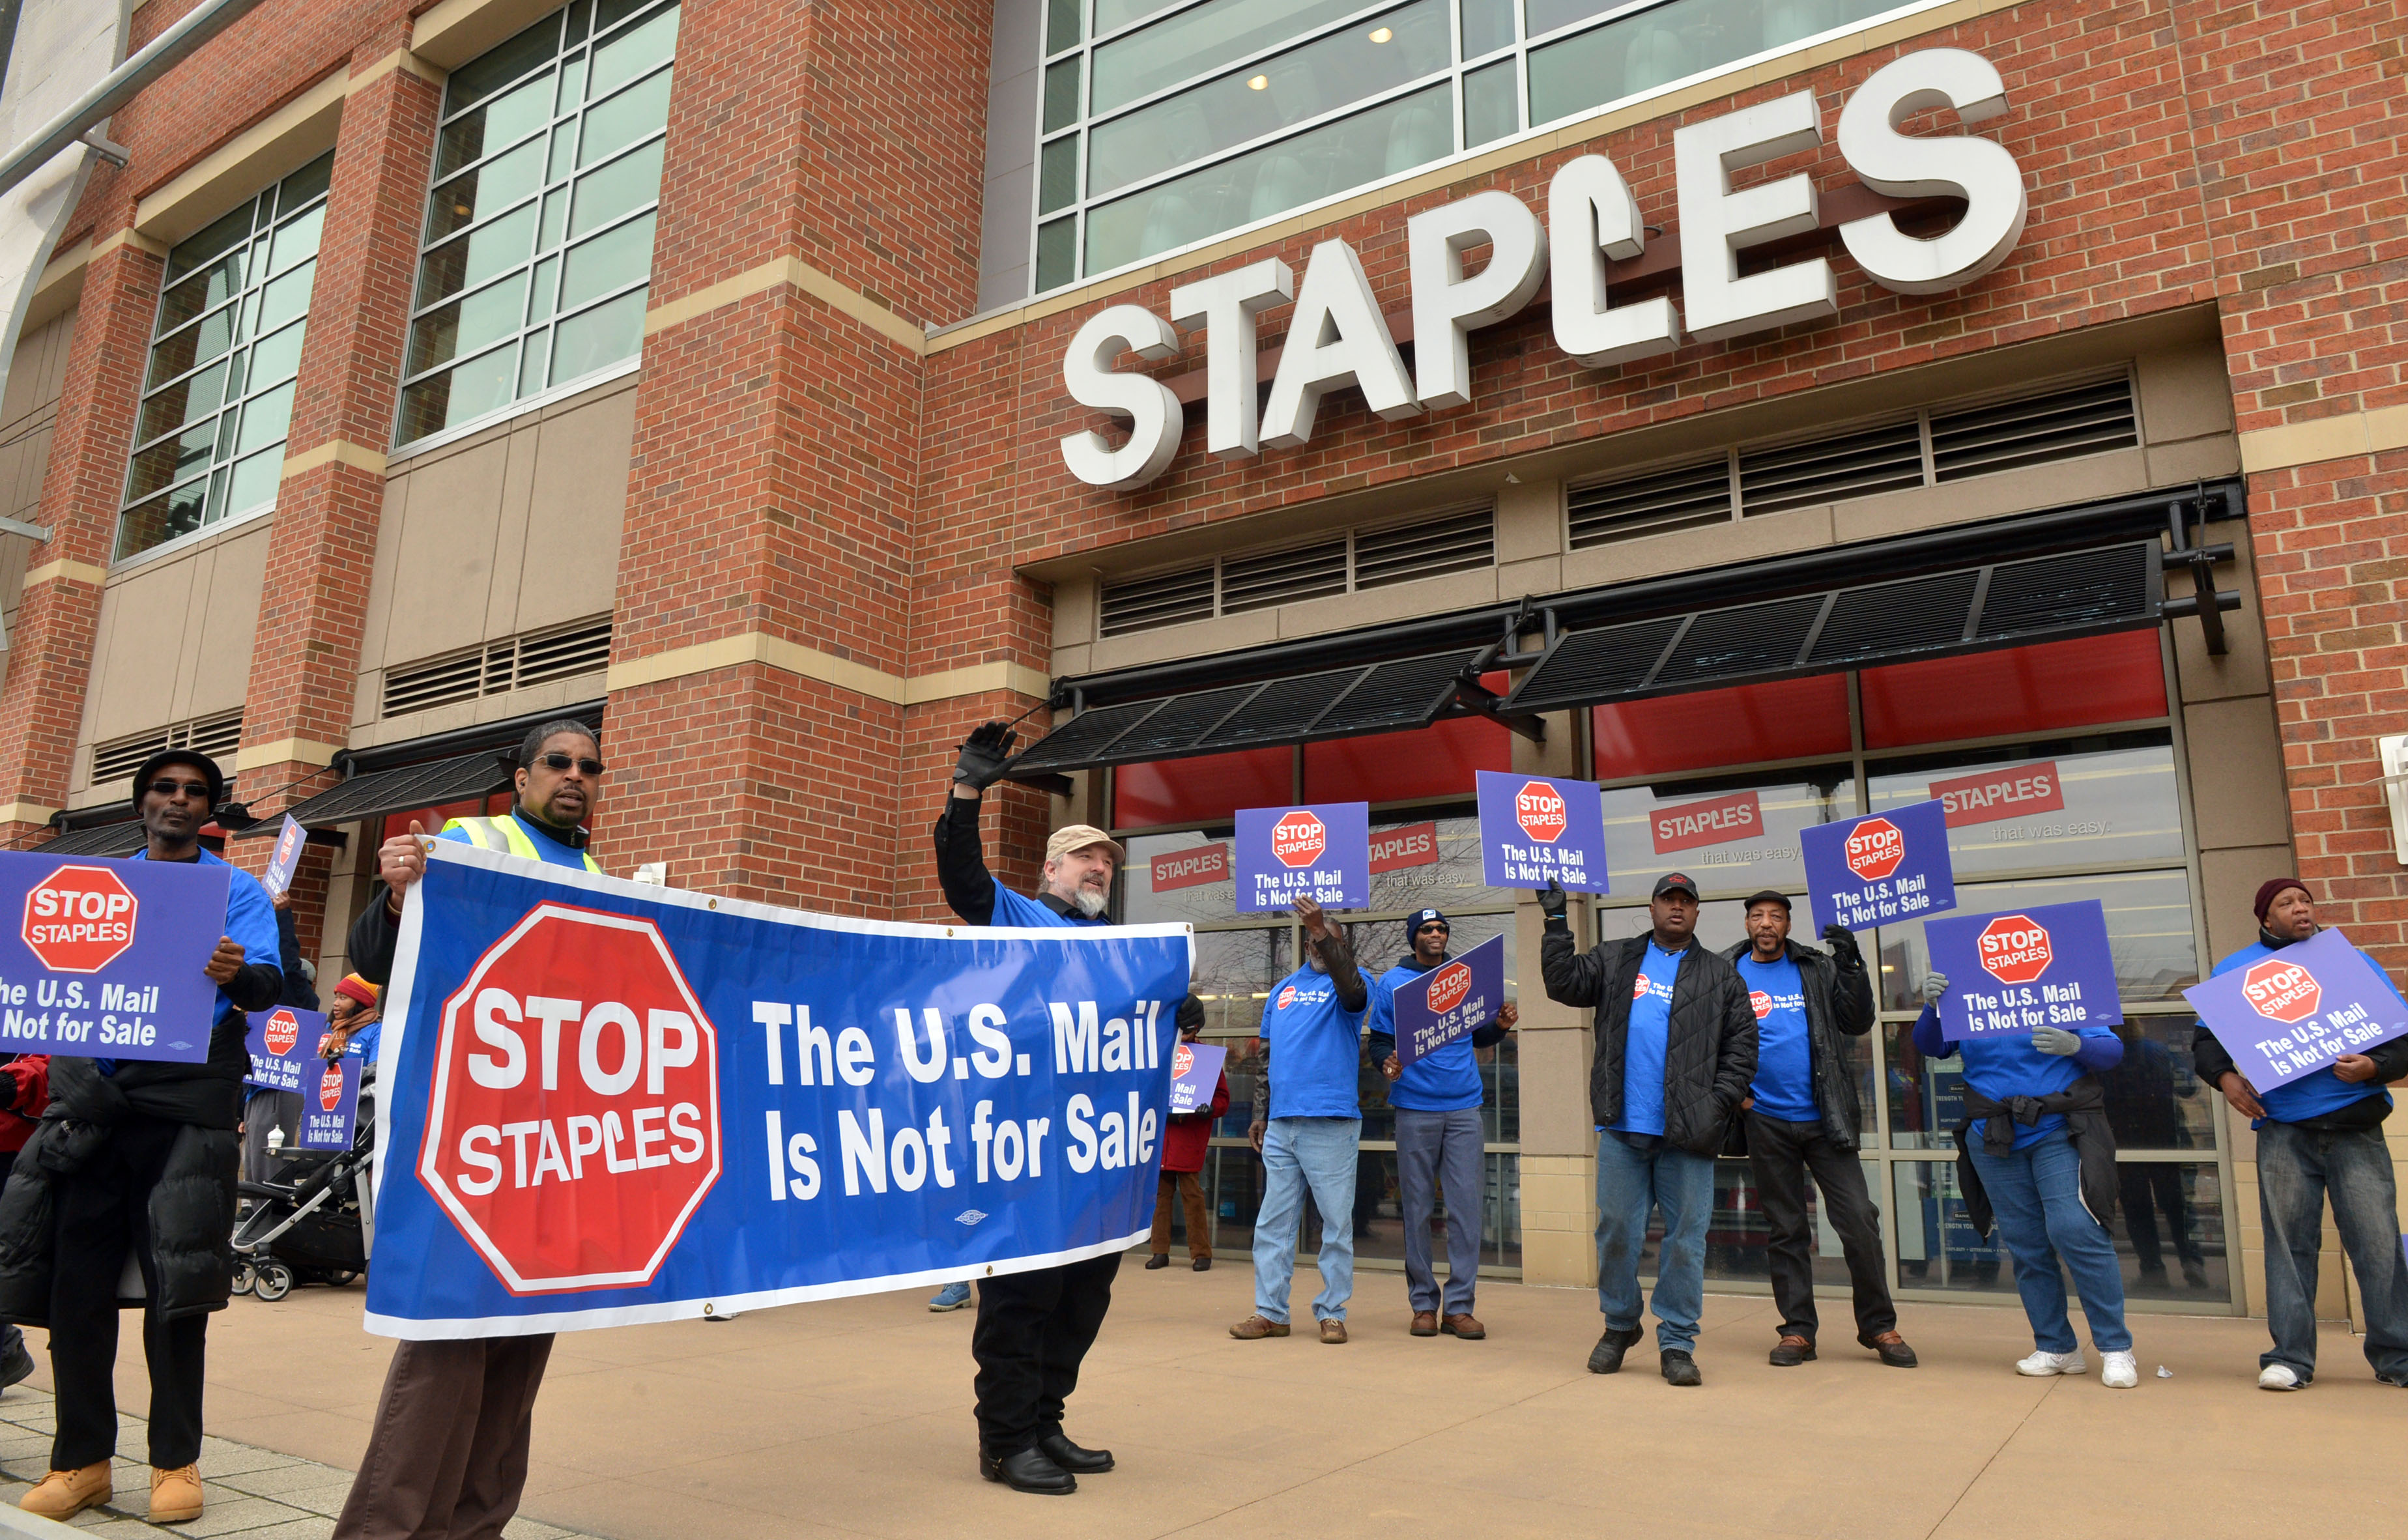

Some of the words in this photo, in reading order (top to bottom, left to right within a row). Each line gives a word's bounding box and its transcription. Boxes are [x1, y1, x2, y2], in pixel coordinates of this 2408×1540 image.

[1060, 47, 2028, 492] STAPLES
[1519, 794, 1562, 813] STOP
[1940, 775, 2052, 814] STAPLES
[1276, 823, 1322, 840] STOP
[1521, 814, 1564, 826] STAPLES
[1658, 804, 1753, 840] STAPLES
[1992, 825, 2024, 841] that
[2030, 823, 2063, 838] was
[2068, 820, 2111, 836] easy.
[1277, 838, 1323, 855] STAPLES
[1368, 834, 1431, 863] TAPLES
[1849, 829, 1898, 854] STOP
[1156, 853, 1222, 880] STAPLES
[1502, 844, 1527, 861] The
[1530, 846, 1556, 864] U.S.
[1558, 848, 1584, 866] Mail
[1702, 851, 1728, 864] that
[1732, 850, 1760, 861] was
[1852, 845, 1901, 870] STAPLES
[1255, 874, 1280, 889] The
[1283, 872, 1310, 887] U.S.
[1314, 870, 1341, 886] Mail
[1386, 874, 1408, 887] that
[1411, 875, 1434, 885] was
[1504, 863, 1516, 879] Is
[1519, 863, 1540, 881] Not
[1542, 864, 1559, 881] for
[1562, 866, 1586, 885] Sale
[1256, 891, 1267, 906] Is
[1270, 889, 1292, 905] Not
[1315, 887, 1343, 903] Sale
[1832, 892, 1861, 909] The
[1863, 883, 1893, 902] U.S.
[1896, 874, 1926, 895] Mail
[34, 888, 130, 920] STOP
[1836, 911, 1850, 926] Is
[1852, 905, 1876, 924] Not
[1879, 900, 1897, 917] for
[1900, 892, 1930, 912] Sale
[32, 922, 128, 943] STAPLES
[1983, 929, 2043, 952] STOP
[1987, 947, 2048, 970] STAPLES
[1431, 968, 1468, 997] STOP
[1431, 979, 1469, 1008] STAPLES
[2246, 967, 2302, 1001] STOP
[0, 977, 27, 1005] he
[36, 979, 91, 1010] U.S.
[100, 983, 160, 1014] Mail
[1750, 995, 1769, 1006] TOP
[1963, 993, 1998, 1011] The
[2001, 988, 2039, 1008] U.S.
[2042, 982, 2082, 1003] Mail
[2261, 980, 2316, 1015] STAPLES
[2, 1009, 50, 1040] Not
[56, 1012, 94, 1042] for
[99, 1015, 156, 1046] Sale
[269, 1020, 296, 1034] STOP
[1414, 1026, 1435, 1043] The
[1438, 1011, 1459, 1029] U.S.
[1463, 995, 1484, 1016] Mail
[1968, 1014, 1985, 1032] Is
[1987, 1010, 2018, 1030] Not
[2021, 1008, 2044, 1026] for
[2048, 1003, 2087, 1024] Sale
[266, 1034, 294, 1044] STAPLES
[466, 987, 698, 1096] STOP
[1415, 1044, 1425, 1056] Is
[1427, 1032, 1446, 1051] Not
[1448, 1023, 1462, 1038] for
[1465, 1010, 1485, 1029] Sale
[2255, 1037, 2294, 1058] The
[2290, 1021, 2331, 1044] U.S.
[2326, 1002, 2368, 1029] Mail
[751, 1001, 876, 1088] The
[894, 1001, 1032, 1085] U.S.
[1048, 999, 1161, 1075] Mail
[2269, 1059, 2292, 1076] Is
[2287, 1044, 2324, 1068] Not
[2318, 1036, 2346, 1056] for
[2343, 1022, 2383, 1045] Sale
[250, 1054, 264, 1068] The
[265, 1057, 280, 1072] U.S.
[283, 1060, 301, 1074] Mail
[1176, 1053, 1191, 1062] OP
[253, 1068, 268, 1083] Not
[268, 1072, 281, 1085] for
[281, 1074, 298, 1089] Sale
[322, 1074, 341, 1087] STOP
[1175, 1083, 1195, 1094] Mail
[321, 1087, 341, 1100] STAPLES
[1173, 1093, 1192, 1105] Sale
[309, 1115, 319, 1128] The
[321, 1115, 331, 1128] U.S.
[332, 1115, 345, 1128] Mail
[308, 1130, 313, 1143] Is
[313, 1130, 322, 1143] Not
[322, 1129, 331, 1143] for
[332, 1130, 343, 1143] Sale
[766, 1109, 821, 1201] Is
[837, 1106, 956, 1197] Not
[971, 1099, 1050, 1182] for
[1065, 1089, 1158, 1176] Sale
[456, 1101, 705, 1197] STAPLES
